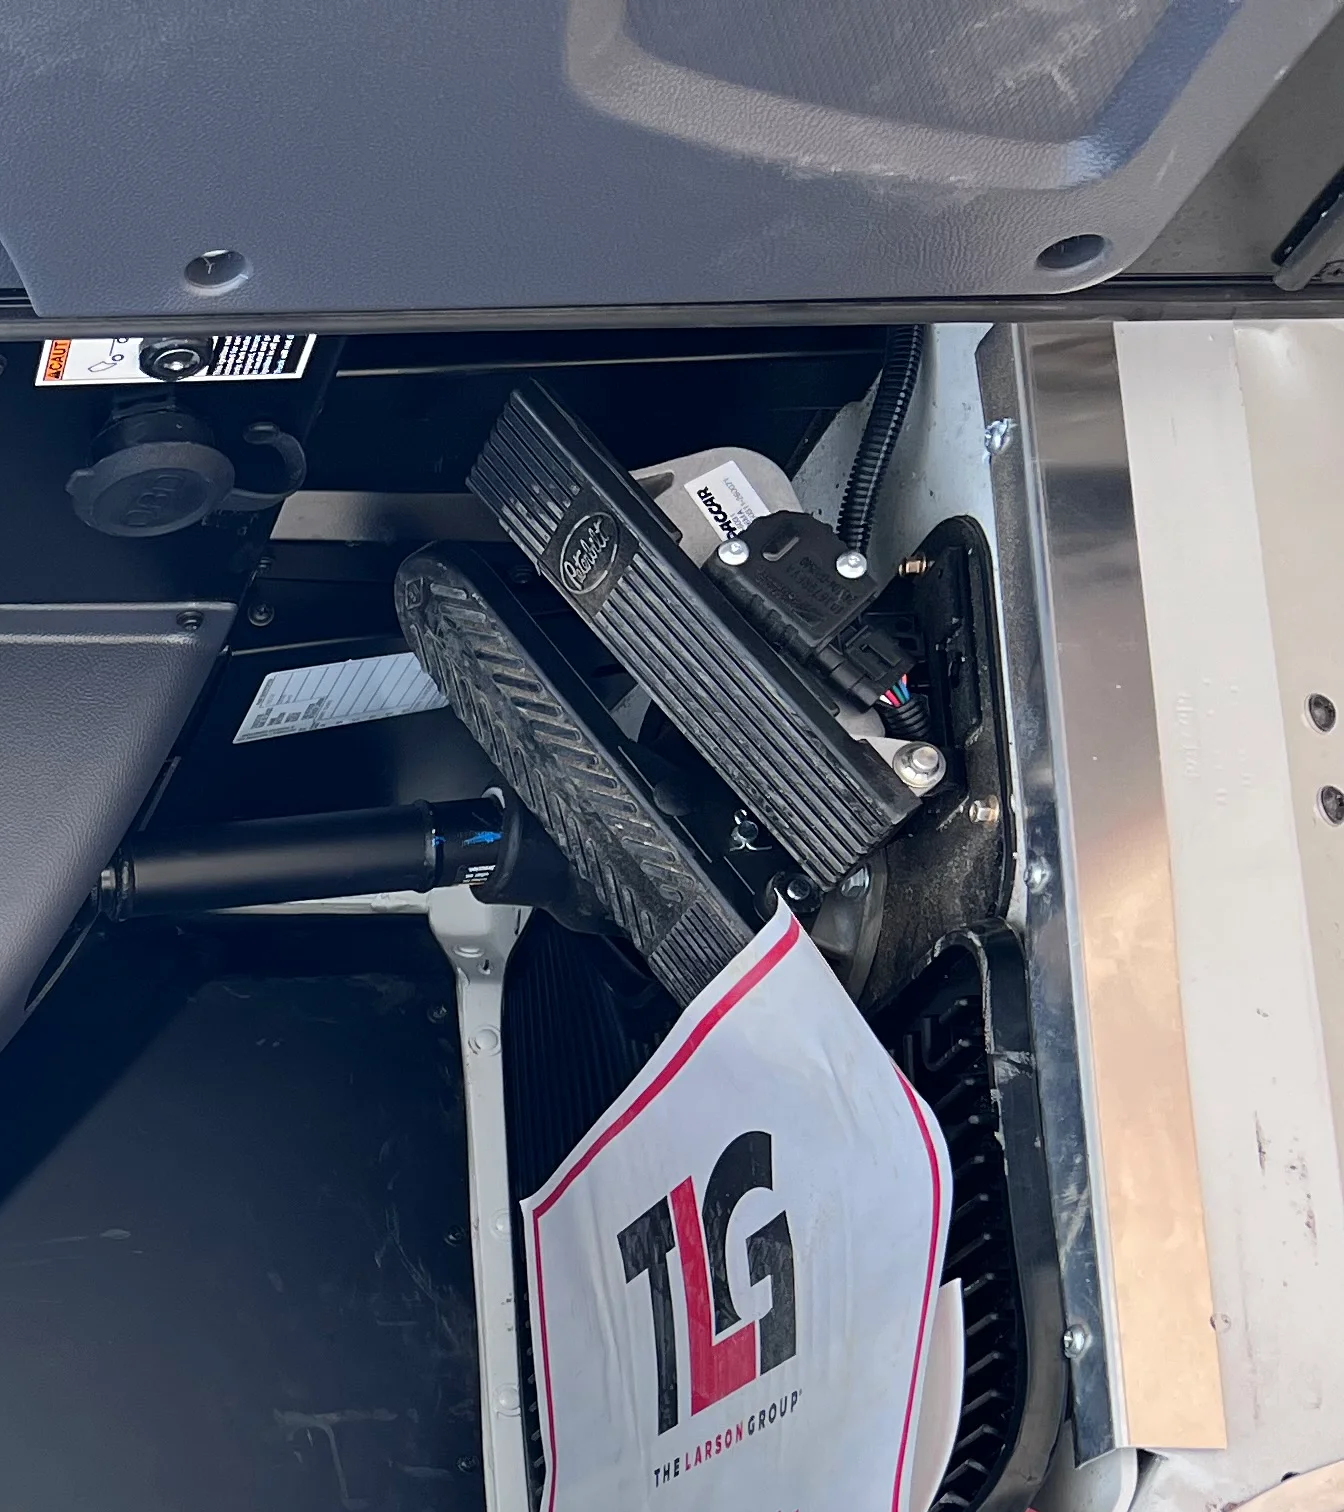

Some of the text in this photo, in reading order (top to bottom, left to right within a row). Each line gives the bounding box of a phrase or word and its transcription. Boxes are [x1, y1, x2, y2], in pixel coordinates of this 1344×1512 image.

[564, 519, 609, 590] Peterbilt
[697, 486, 737, 540] PACCAR
[617, 1130, 796, 1436] TLG
[654, 1390, 799, 1487] THE LARSON GROUP
